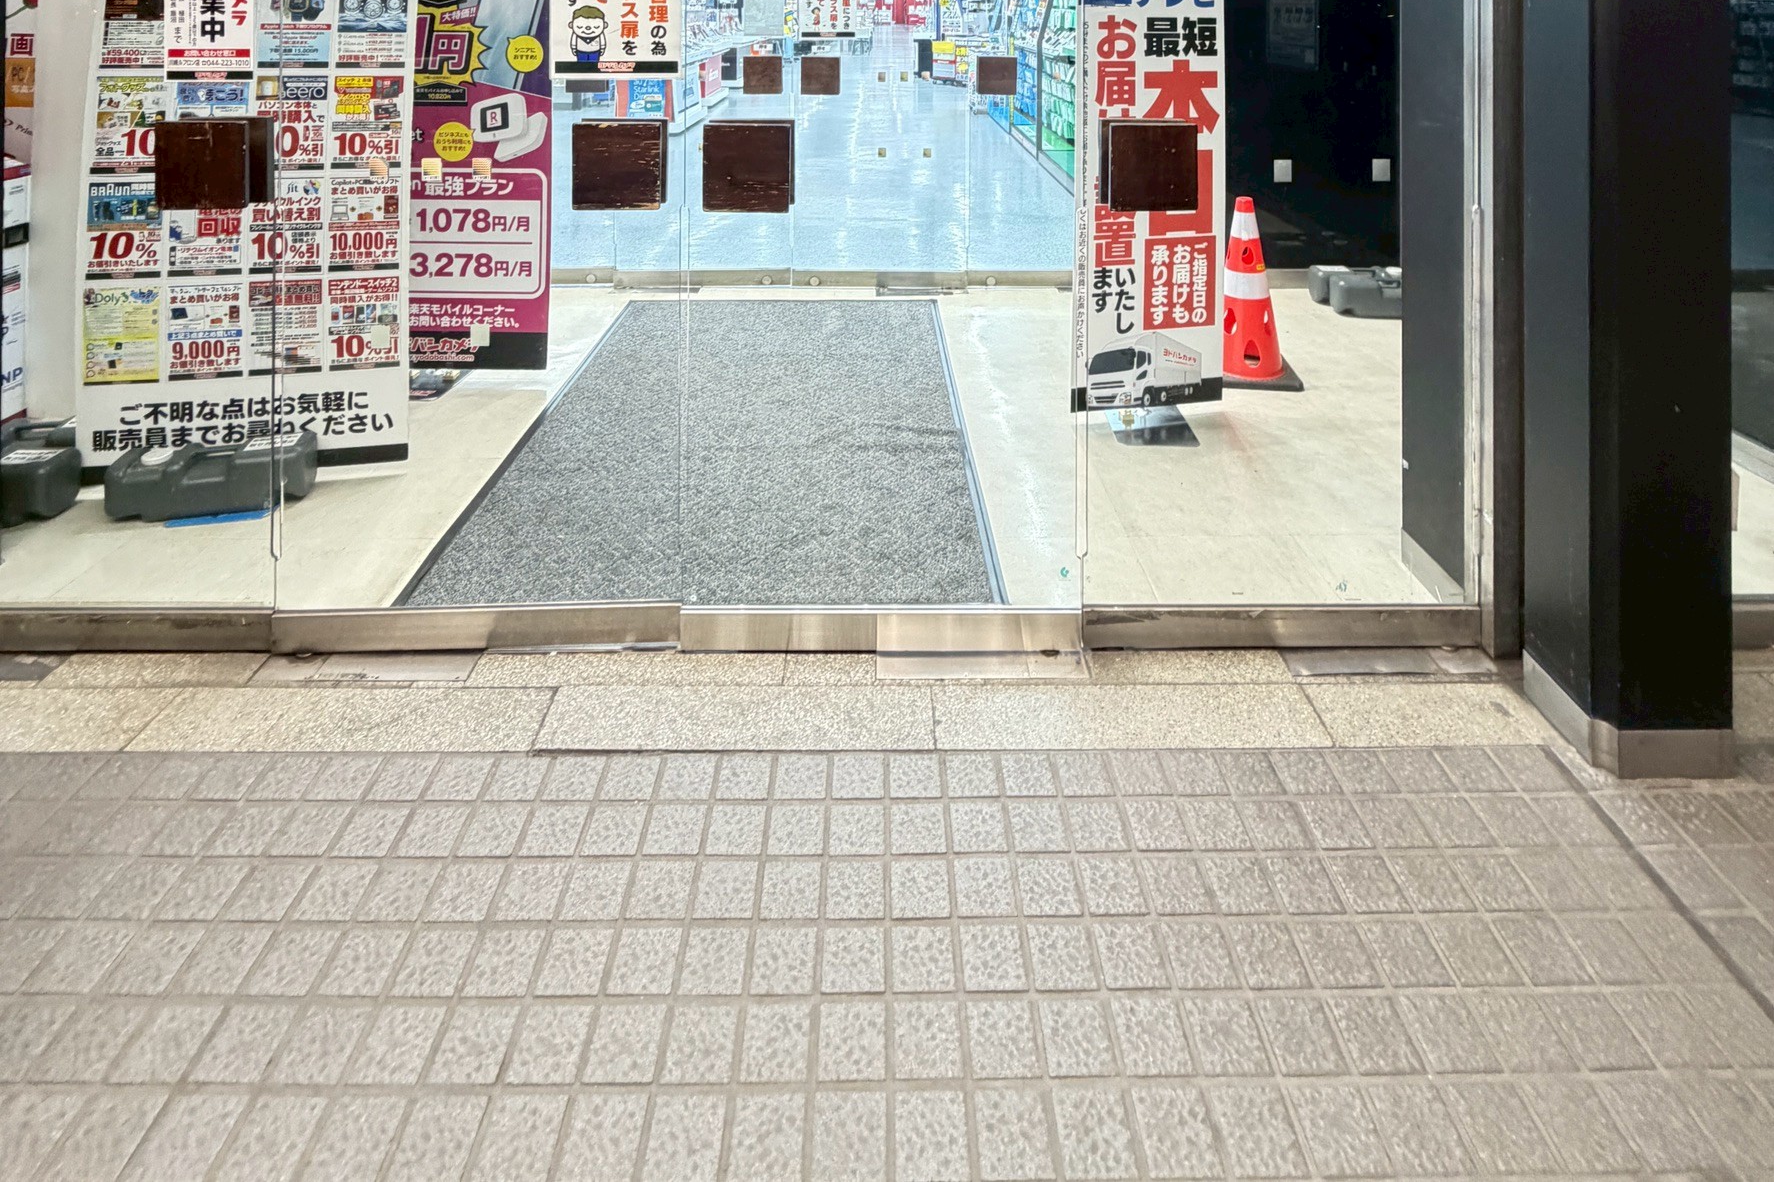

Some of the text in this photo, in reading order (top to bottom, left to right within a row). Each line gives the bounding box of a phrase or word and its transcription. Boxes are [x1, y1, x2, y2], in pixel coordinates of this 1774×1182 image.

[441, 7, 477, 23] 大特価!!
[10, 32, 35, 56] 画
[1144, 17, 1217, 57] 最短
[633, 85, 660, 93] Starlink
[333, 132, 400, 156] 10%引
[438, 131, 469, 139] ビジネスにも
[90, 183, 131, 197] BRAUN
[331, 185, 398, 195] まとめ買いがお得
[424, 175, 515, 197] 最強プラン
[198, 217, 242, 238] 回収
[415, 207, 531, 233] 1,078円/月
[90, 231, 158, 260] 10%
[329, 231, 398, 251] 10,000円
[87, 259, 160, 268] お値引きいたします
[329, 250, 399, 260] お値引き致します
[409, 252, 533, 278] 3,278円/月
[1091, 266, 1113, 314] ます
[1150, 244, 1170, 325] 承ります
[1172, 243, 1191, 324] お届けも
[1191, 241, 1208, 324] ご指定日の
[169, 293, 240, 305] まとめ買いがお得
[409, 303, 516, 316] 楽天モバイルコーナー
[1114, 267, 1136, 335] いたし
[409, 315, 520, 329] お問い合わせください。
[172, 339, 241, 361] 9,000円
[169, 358, 242, 369] お値引き致します
[118, 390, 369, 426] ご不明な点はお気軽に
[91, 412, 394, 453] 販売員までお尋ねください
